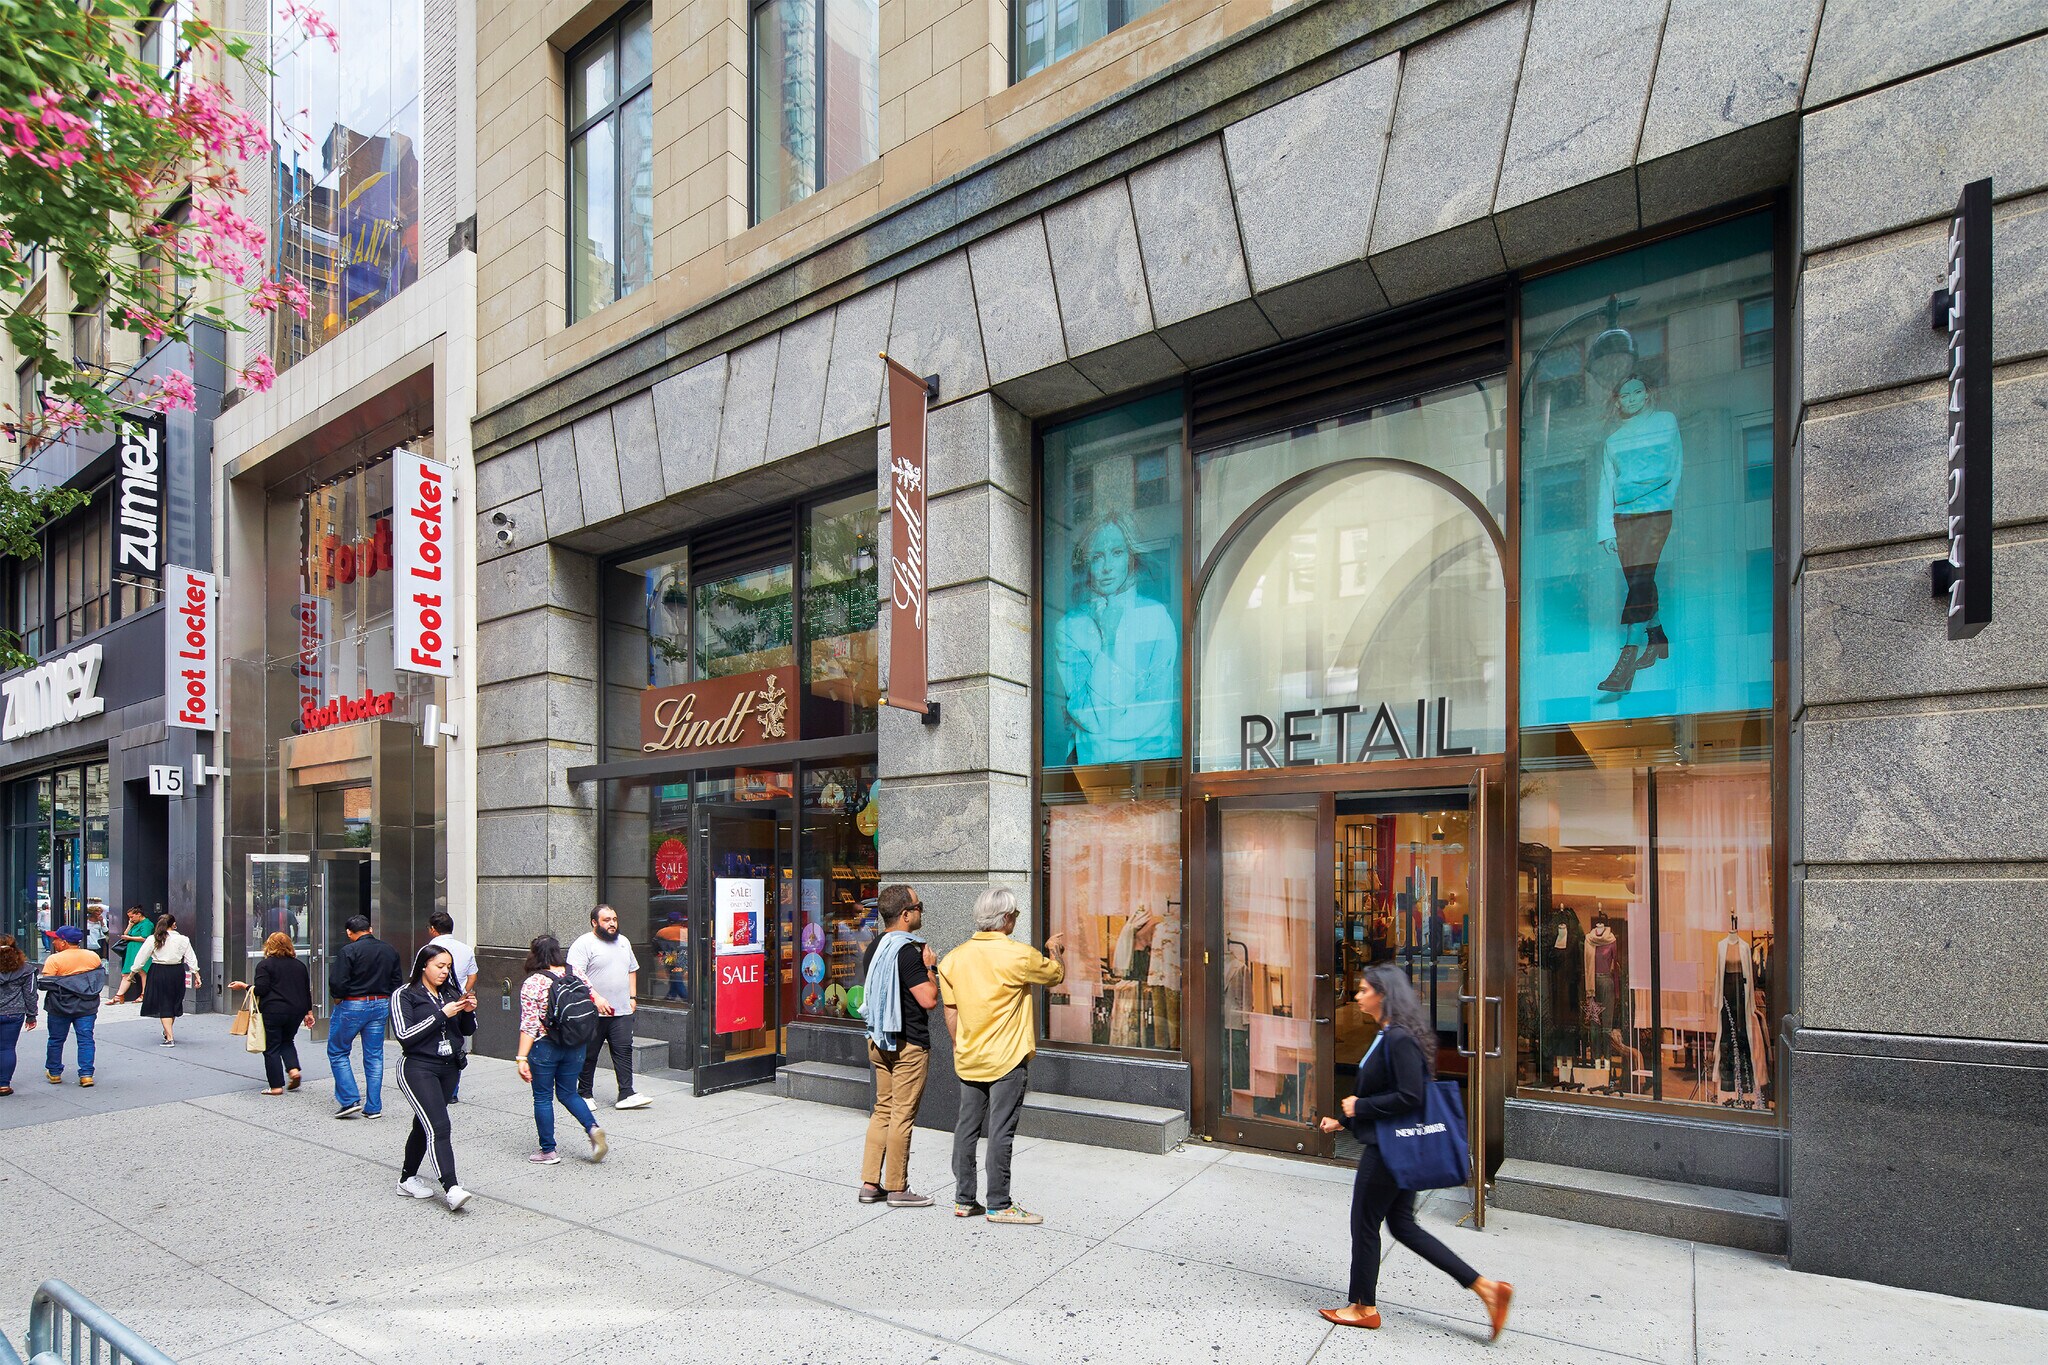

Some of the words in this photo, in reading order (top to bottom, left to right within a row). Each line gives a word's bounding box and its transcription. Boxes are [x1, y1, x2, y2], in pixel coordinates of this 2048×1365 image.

[1947, 217, 1963, 618] NATURALIZER
[411, 464, 442, 581] Locker
[892, 486, 922, 630] Lindt
[180, 573, 207, 659] Locker
[411, 594, 442, 668] Foot
[179, 670, 207, 725] Foot
[643, 690, 757, 753] Lindt
[1240, 696, 1477, 770] RETAIL
[154, 769, 181, 791] 15
[661, 863, 683, 874] SALE
[722, 965, 759, 985] SALE
